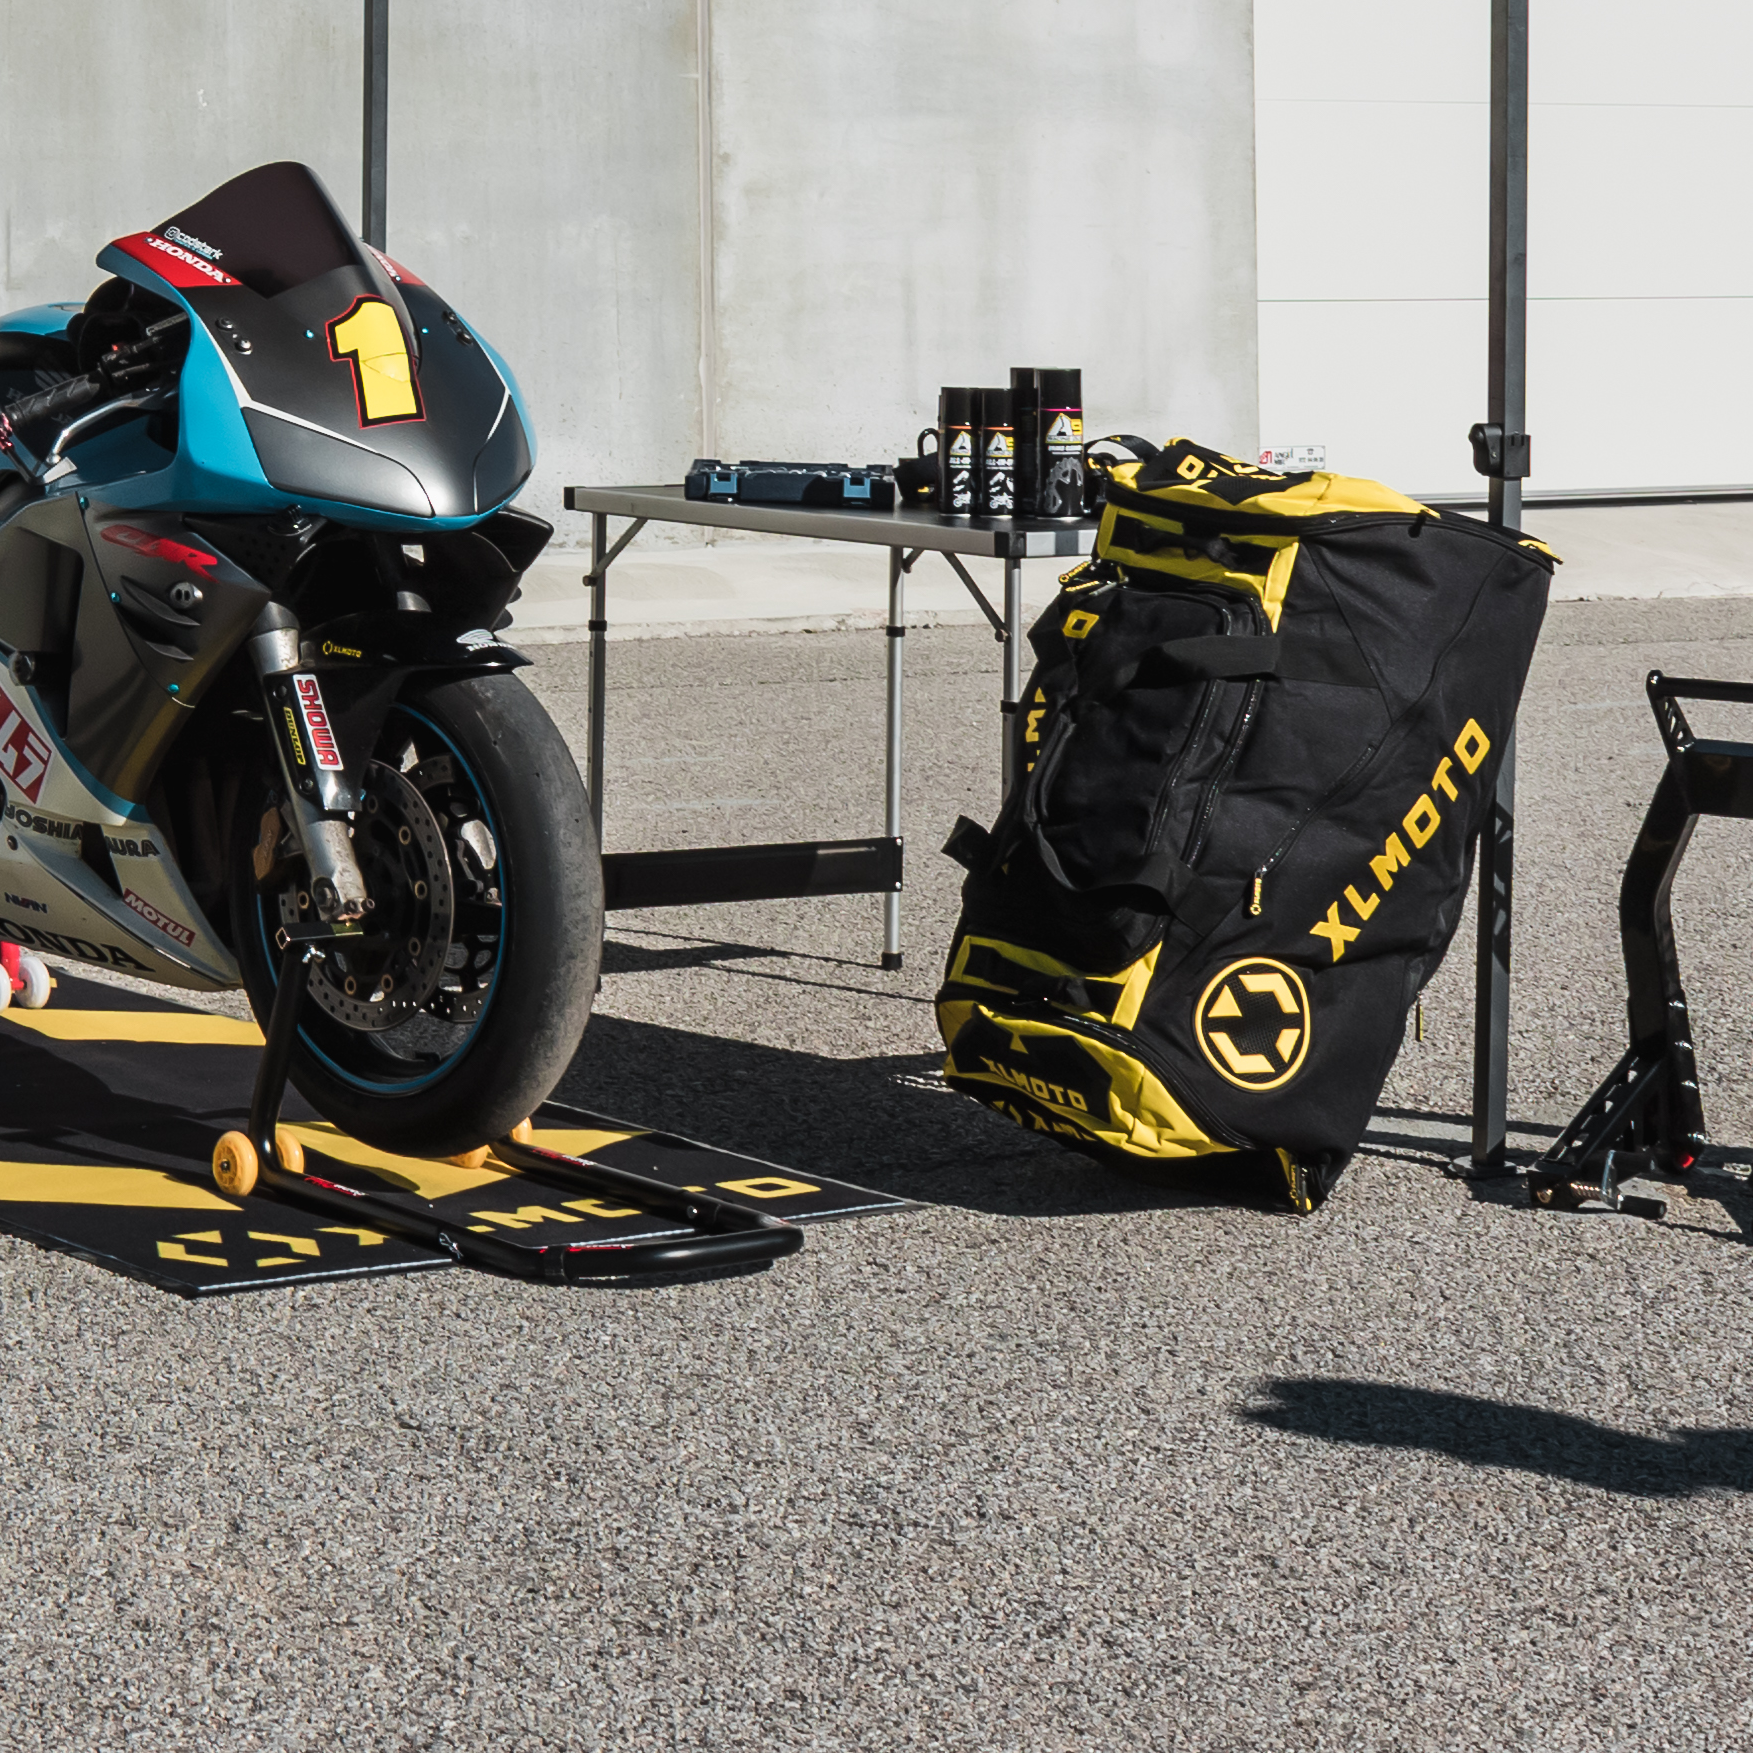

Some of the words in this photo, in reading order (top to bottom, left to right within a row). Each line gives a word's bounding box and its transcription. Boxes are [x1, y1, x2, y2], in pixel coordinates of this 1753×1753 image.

[149, 237, 224, 284] HONDA
[327, 295, 425, 428] 1
[332, 645, 363, 659] XLMOTO
[285, 708, 306, 765] DUNLOP
[296, 678, 340, 766] SHOWA
[1309, 717, 1491, 963] XLMOTO
[124, 891, 192, 946] MOTUL
[979, 1055, 1089, 1113] XLMOTO
